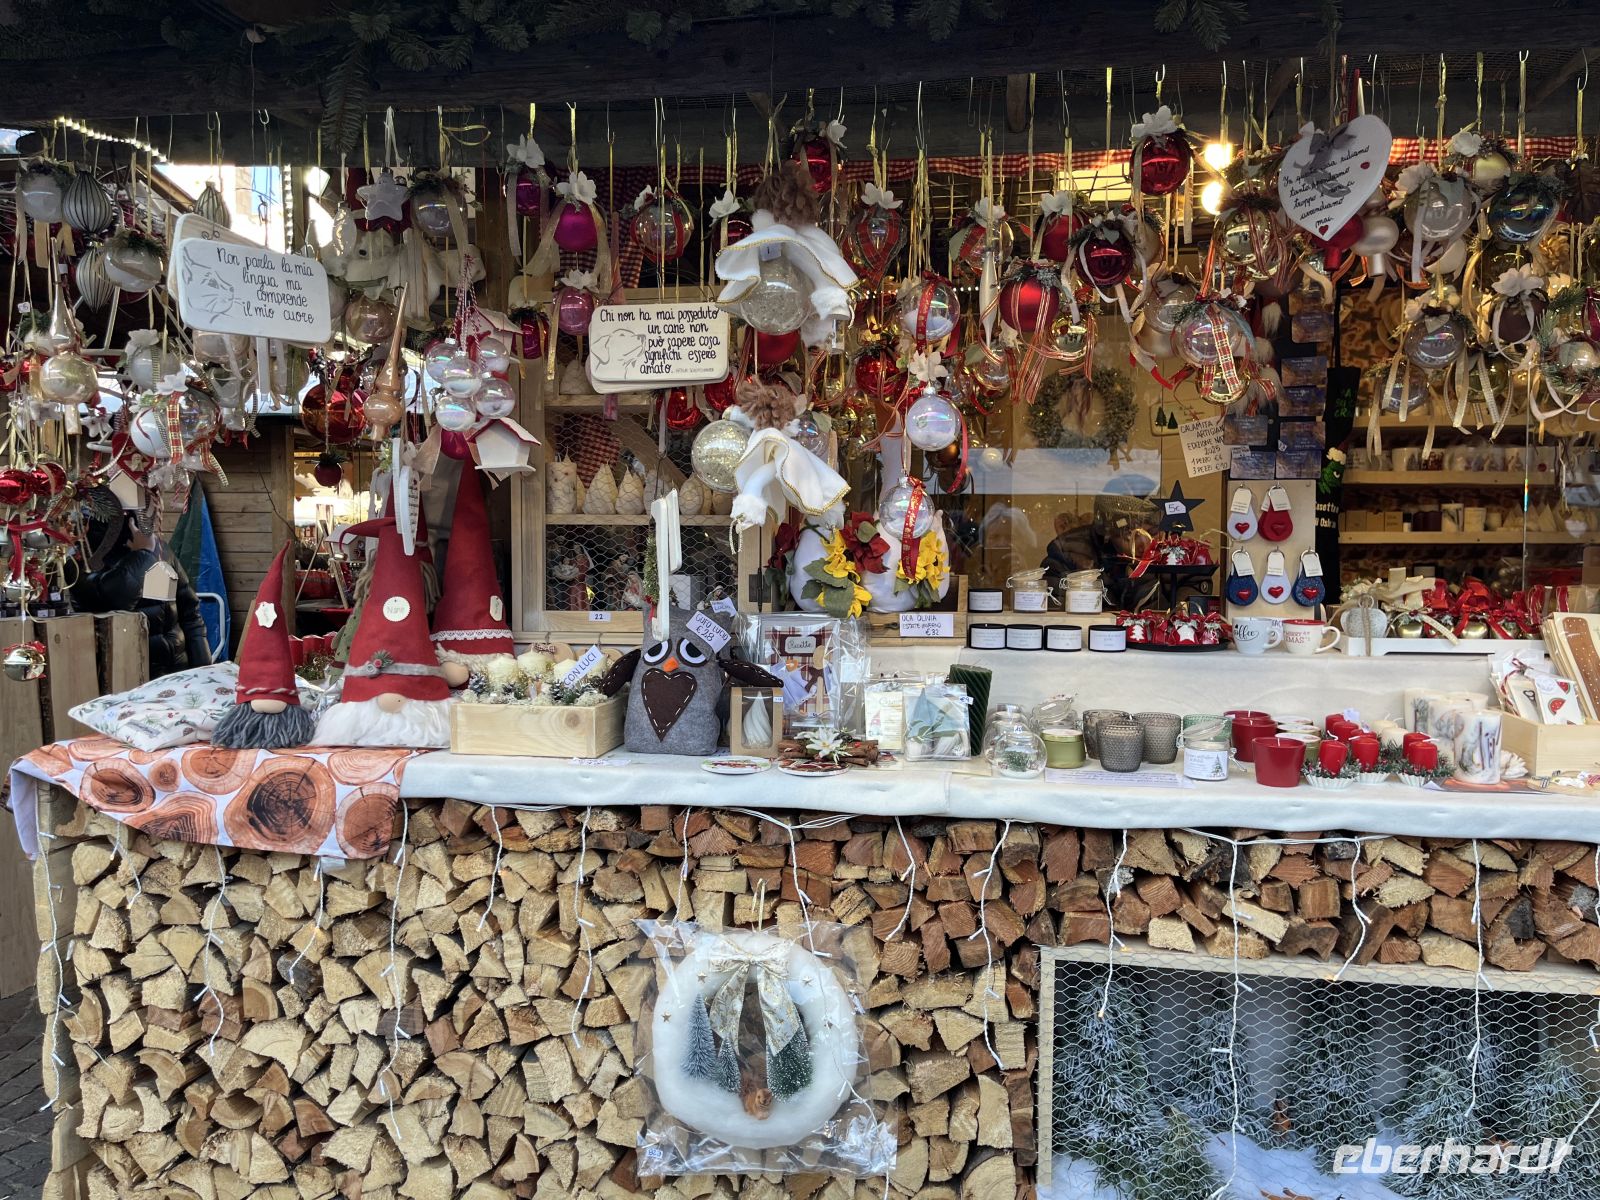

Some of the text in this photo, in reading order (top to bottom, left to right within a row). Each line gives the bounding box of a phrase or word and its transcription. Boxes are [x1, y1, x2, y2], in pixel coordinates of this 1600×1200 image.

[216, 247, 314, 277] Non parla la mia
[242, 267, 303, 291] lingua ma
[242, 301, 315, 324] il mio cuore
[600, 306, 720, 323] Chi non ha mai posseduto
[647, 322, 709, 334] un cane non
[667, 337, 696, 351] sapere
[644, 348, 717, 365] significhi essere
[1180, 420, 1213, 434] CALAMITA
[901, 614, 914, 622] OCA
[563, 652, 597, 686] CON LUCI
